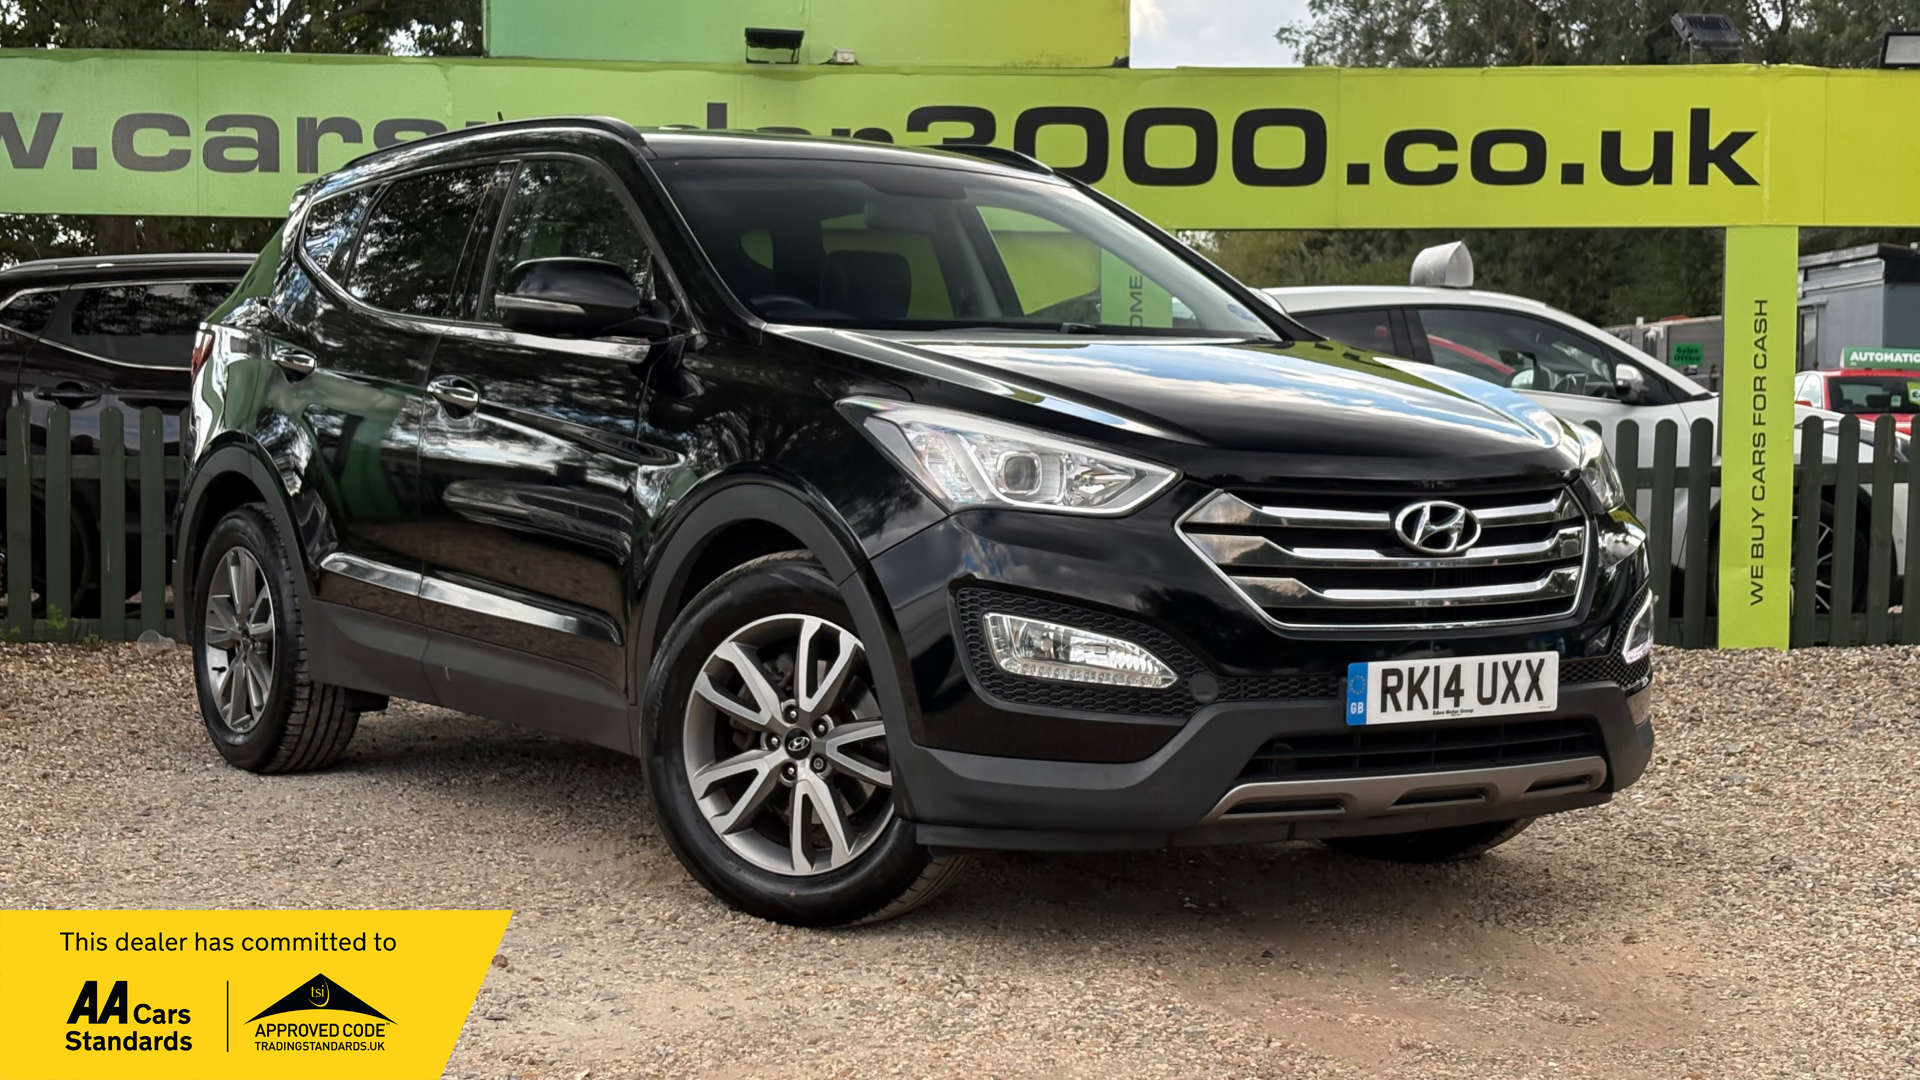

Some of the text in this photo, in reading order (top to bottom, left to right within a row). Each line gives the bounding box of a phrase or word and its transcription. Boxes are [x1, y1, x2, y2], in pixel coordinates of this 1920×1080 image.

[1750, 299, 1768, 606] WE BUY CARS FOR CASH
[1350, 702, 1364, 714] GB
[1380, 658, 1546, 713] RK14 UXX
